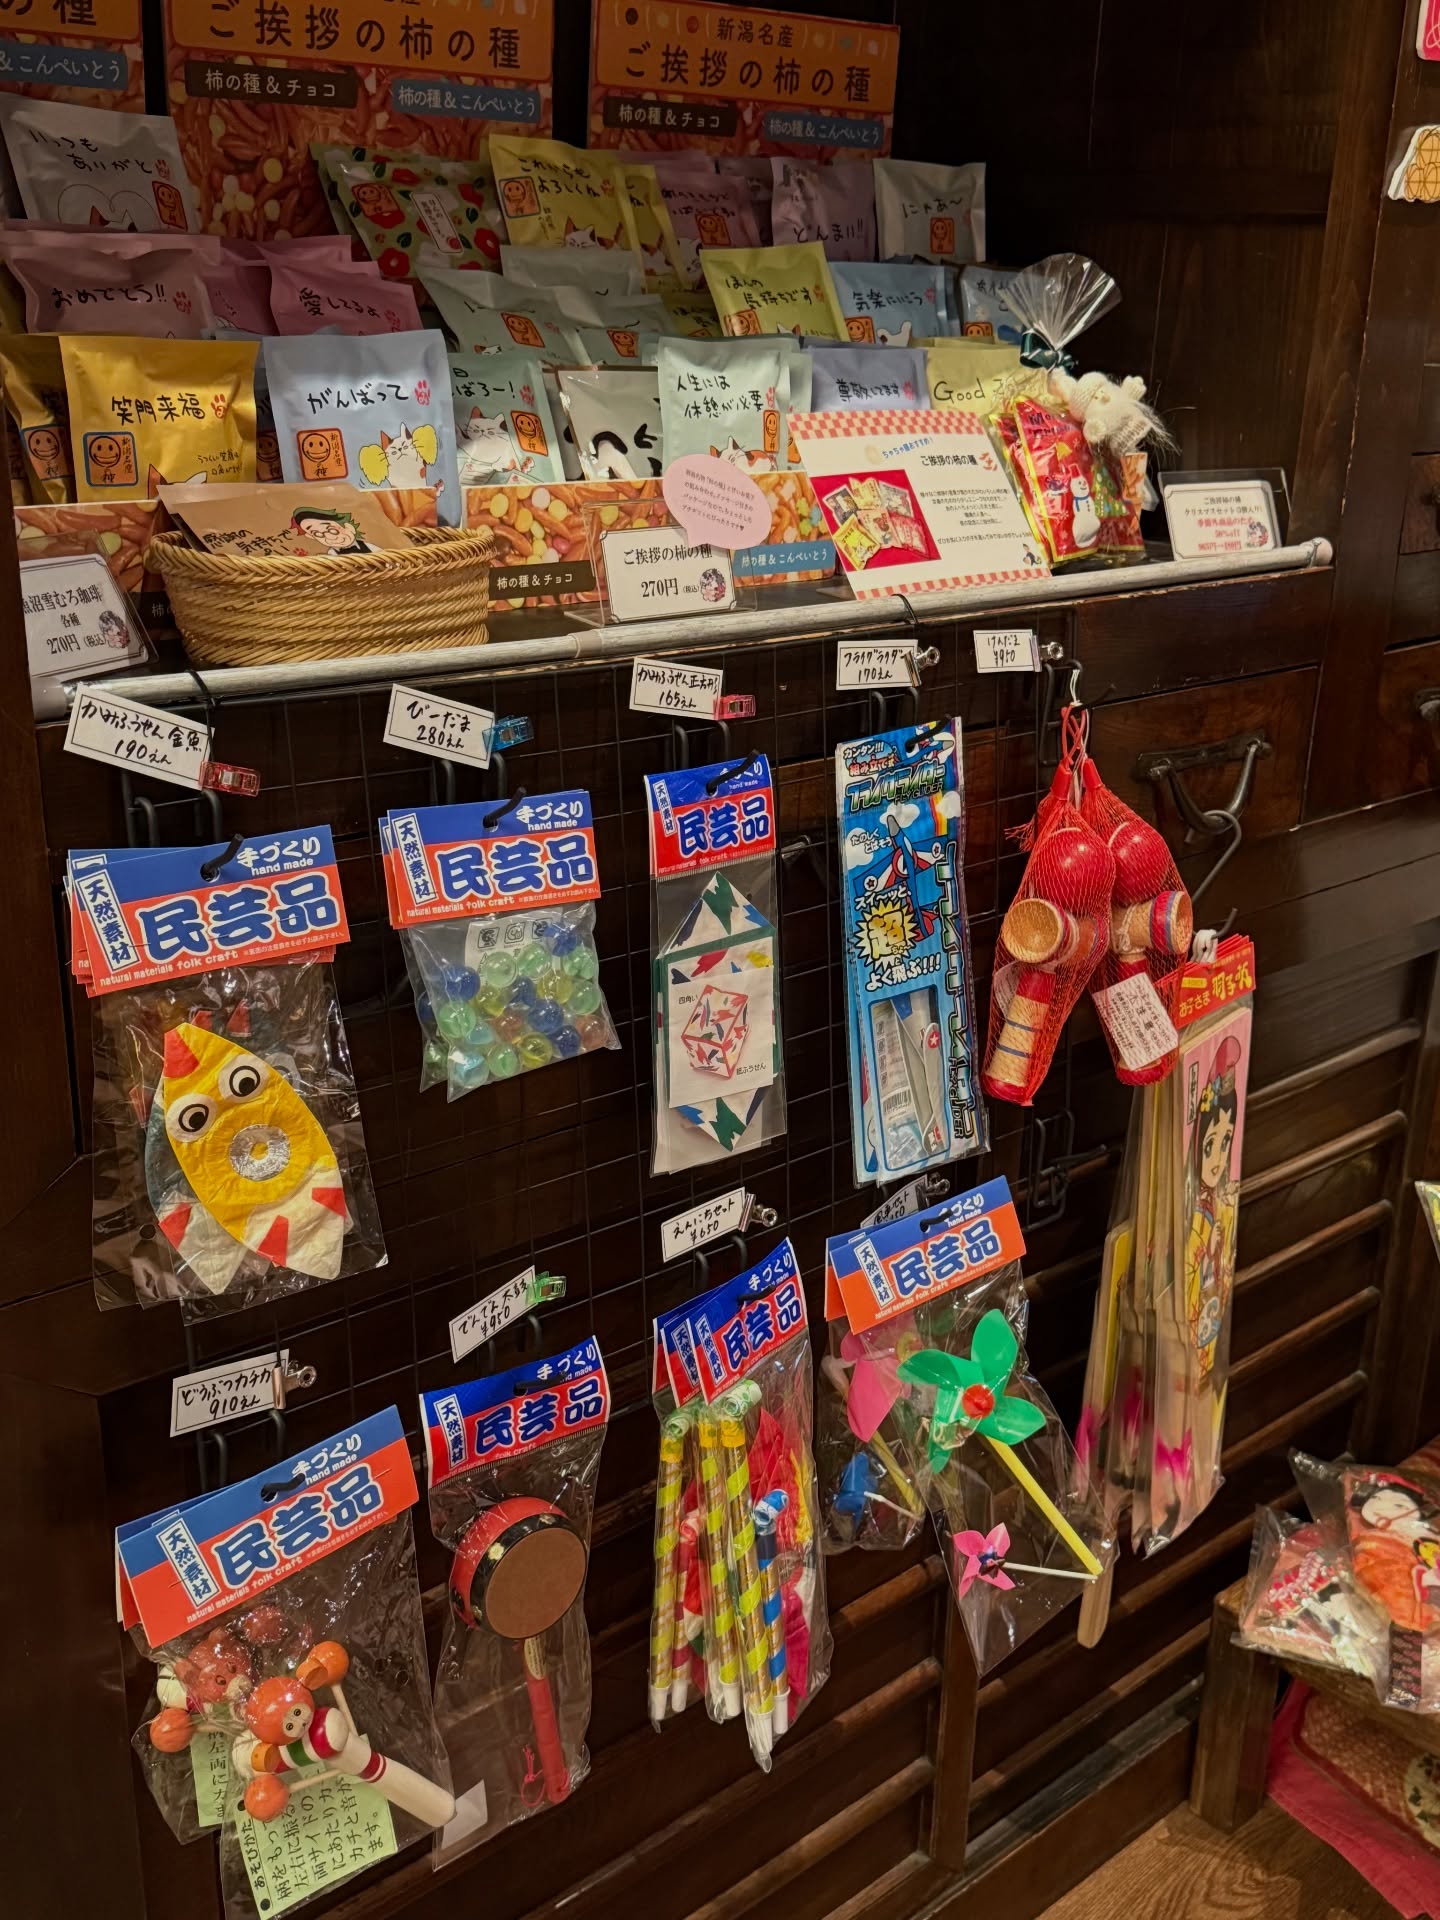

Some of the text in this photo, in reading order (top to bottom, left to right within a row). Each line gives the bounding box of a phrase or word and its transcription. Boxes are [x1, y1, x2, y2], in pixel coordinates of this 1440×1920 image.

[209, 0, 522, 71] ご挨拶の柿の種
[717, 17, 794, 48] 新潟名産
[625, 43, 871, 103] ご挨拶の柿の種
[111, 393, 205, 426] 笑門来福
[306, 382, 409, 414] がんばって
[932, 377, 985, 404] Good
[622, 543, 713, 567] ご挨拶の柿の種
[641, 577, 679, 599] 270円
[60, 612, 82, 629] 各種
[46, 633, 81, 655] 270円
[858, 667, 893, 683] 170えん
[406, 700, 472, 732] びーだま
[658, 688, 697, 709] 165えん
[114, 739, 172, 765] 190えん
[416, 723, 465, 750] 280えん
[516, 800, 584, 825] 手づくり
[527, 818, 578, 832] hand made
[677, 793, 771, 858] 民芸品
[237, 836, 321, 867] 手づくり
[251, 857, 314, 878] hand made
[397, 819, 433, 899] 天然素材
[436, 833, 597, 901] 民芸品
[83, 877, 134, 965] 天然素材
[135, 871, 340, 965] 民芸品
[466, 897, 487, 911] folk
[488, 894, 515, 907] craft
[867, 909, 907, 961] 超
[99, 949, 239, 988] natural materials folk craft
[865, 952, 941, 992] よく飛ぶ!!!
[690, 1220, 720, 1244] ¥650
[748, 1252, 793, 1291] 手づくり
[859, 1245, 891, 1303] 天然素材
[889, 1217, 1002, 1298] 民芸品
[458, 1278, 529, 1335] でんでん太鼓
[721, 1281, 803, 1373] 民芸品
[536, 1343, 597, 1381] 手づくり
[574, 1364, 593, 1378] made
[209, 1395, 261, 1421] 910えん
[475, 1376, 604, 1456] 民芸品
[440, 1400, 465, 1464] 天然素材
[291, 1433, 362, 1475] 手づくり
[305, 1453, 358, 1486] hand made
[212, 1462, 385, 1590] 民芸品
[165, 1526, 213, 1601] 天然素材
[186, 1602, 215, 1624] natural
[251, 1572, 275, 1590] folk
[300, 1794, 329, 1882] 両サイドの
[364, 1811, 385, 1853] ます。
[241, 1817, 266, 1891] あそびかた
